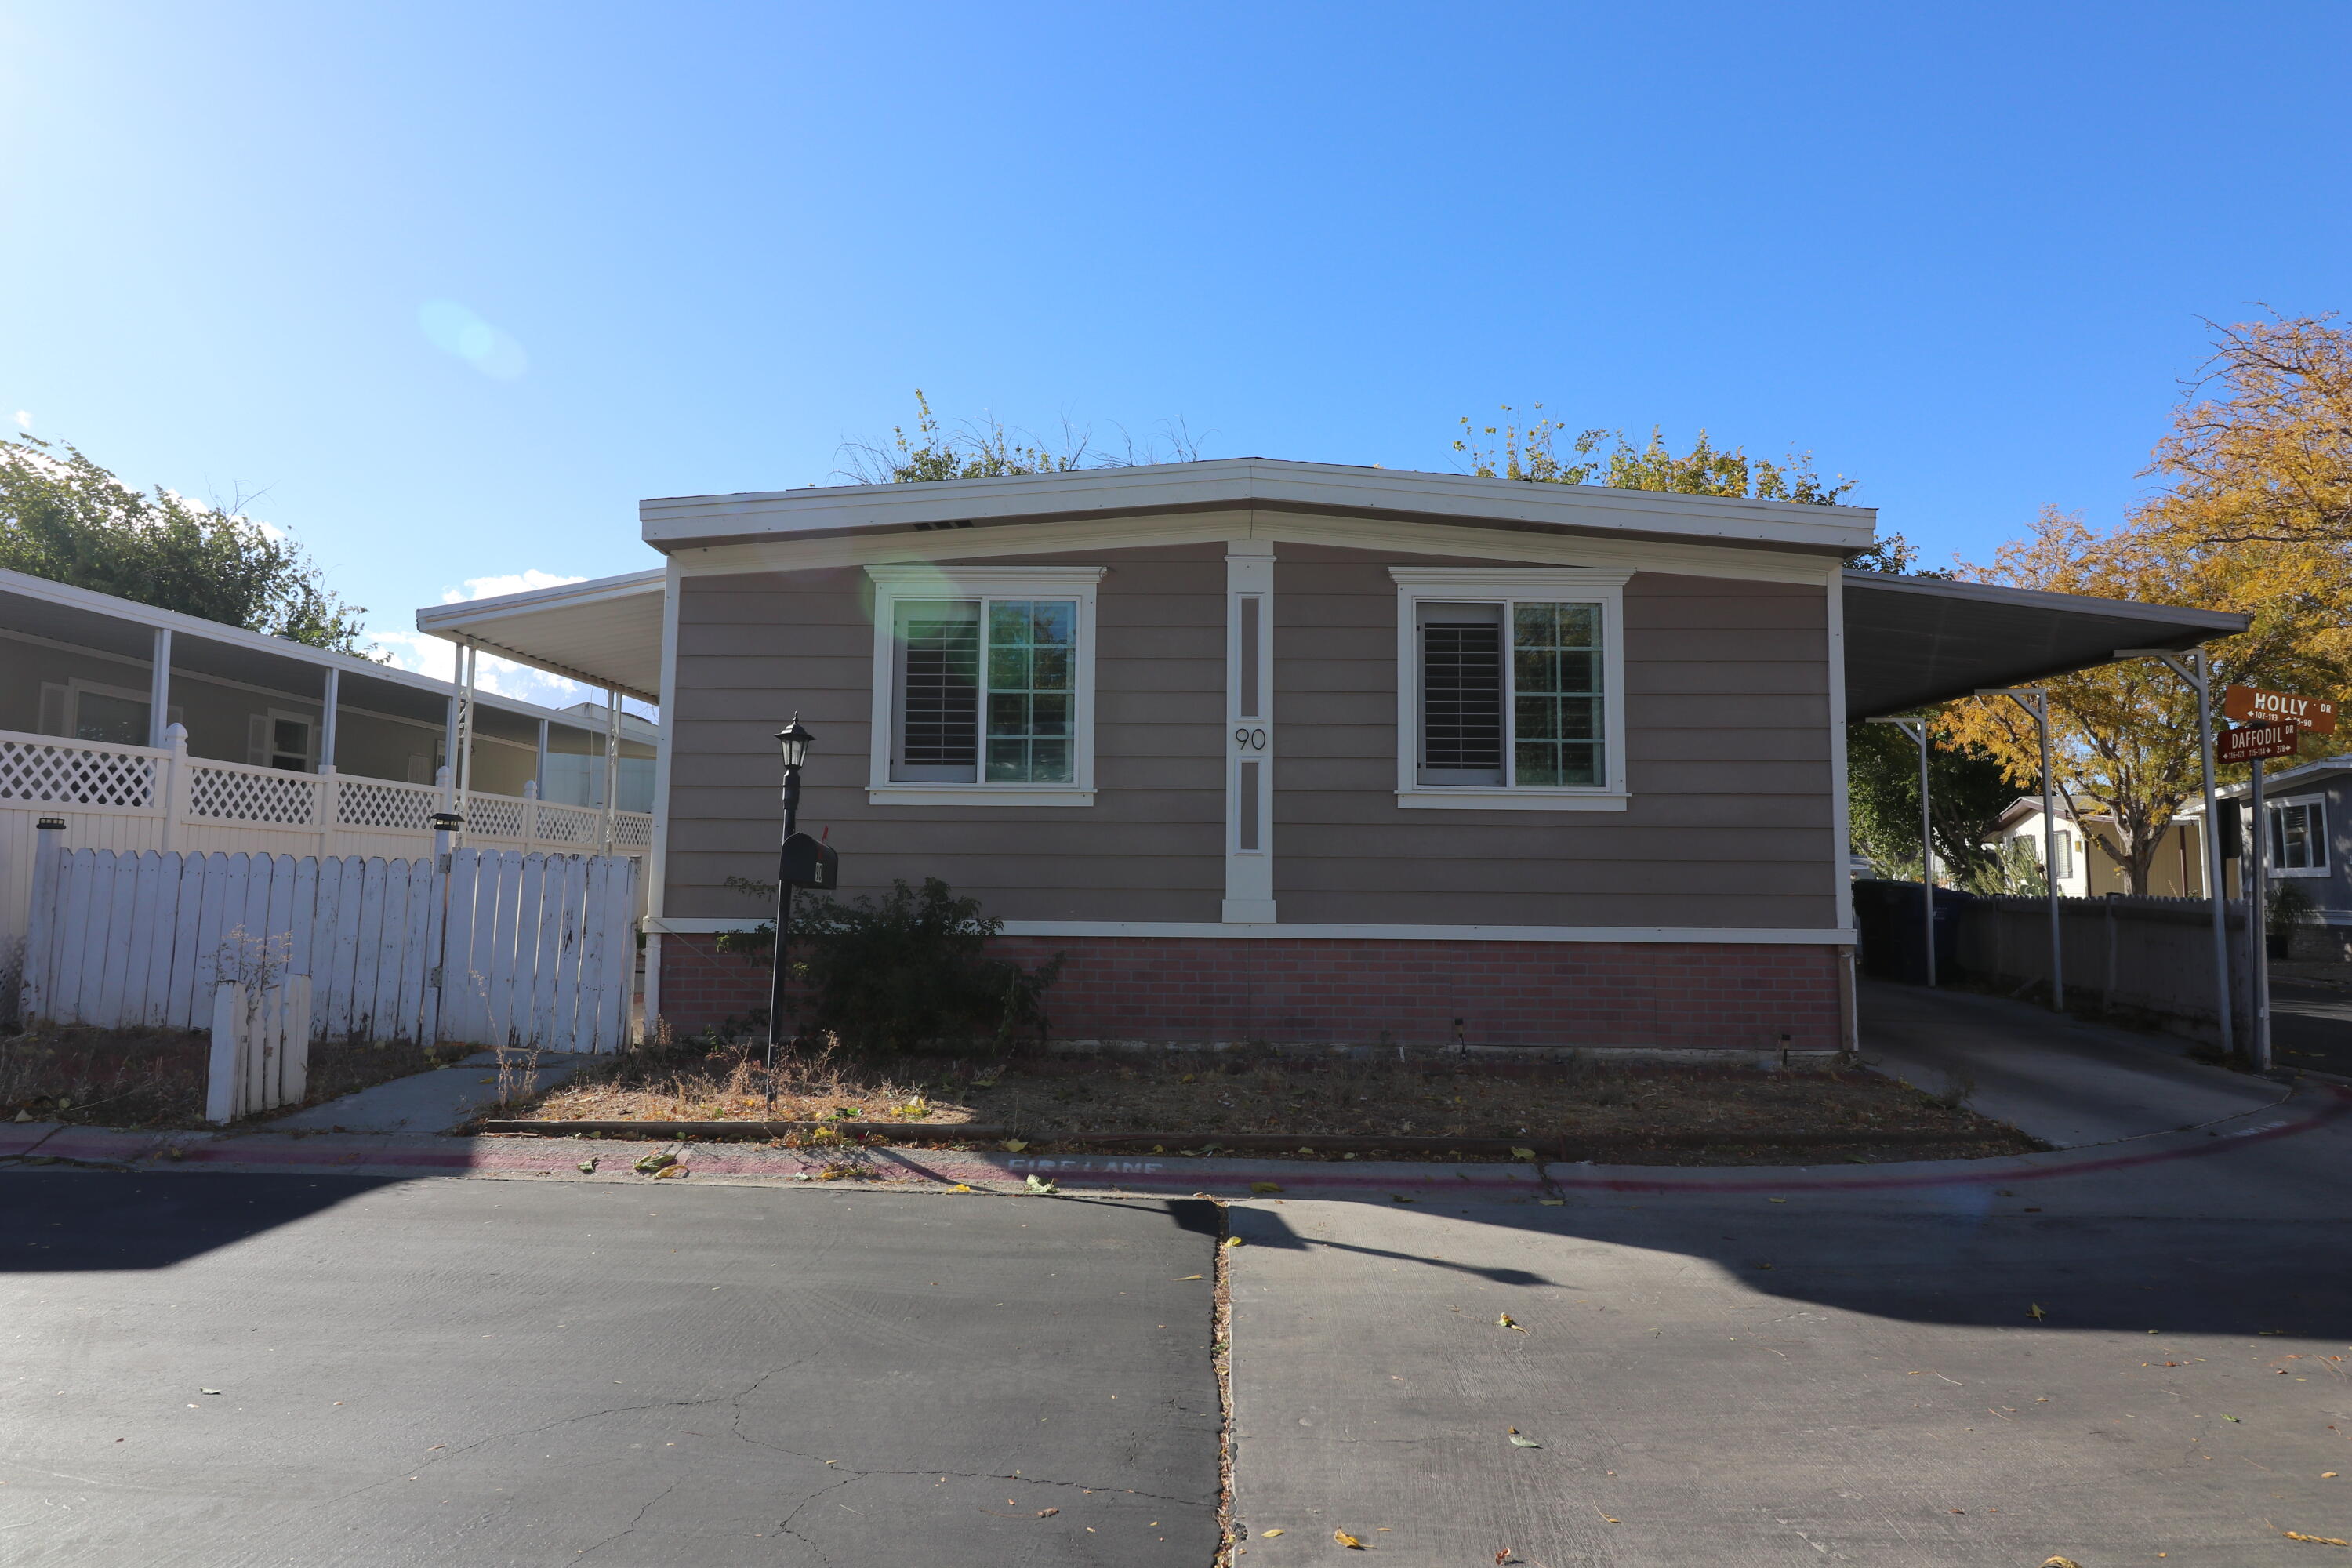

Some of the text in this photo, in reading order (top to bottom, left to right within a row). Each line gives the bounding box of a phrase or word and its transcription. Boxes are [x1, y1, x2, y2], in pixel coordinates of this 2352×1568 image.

[2254, 692, 2332, 716] HOLLY DR
[2255, 711, 2278, 722] 107-113
[1236, 728, 1265, 750] 90
[2232, 725, 2294, 749] DAFFODIL DR
[1008, 1159, 1163, 1174] FIRE LANE
